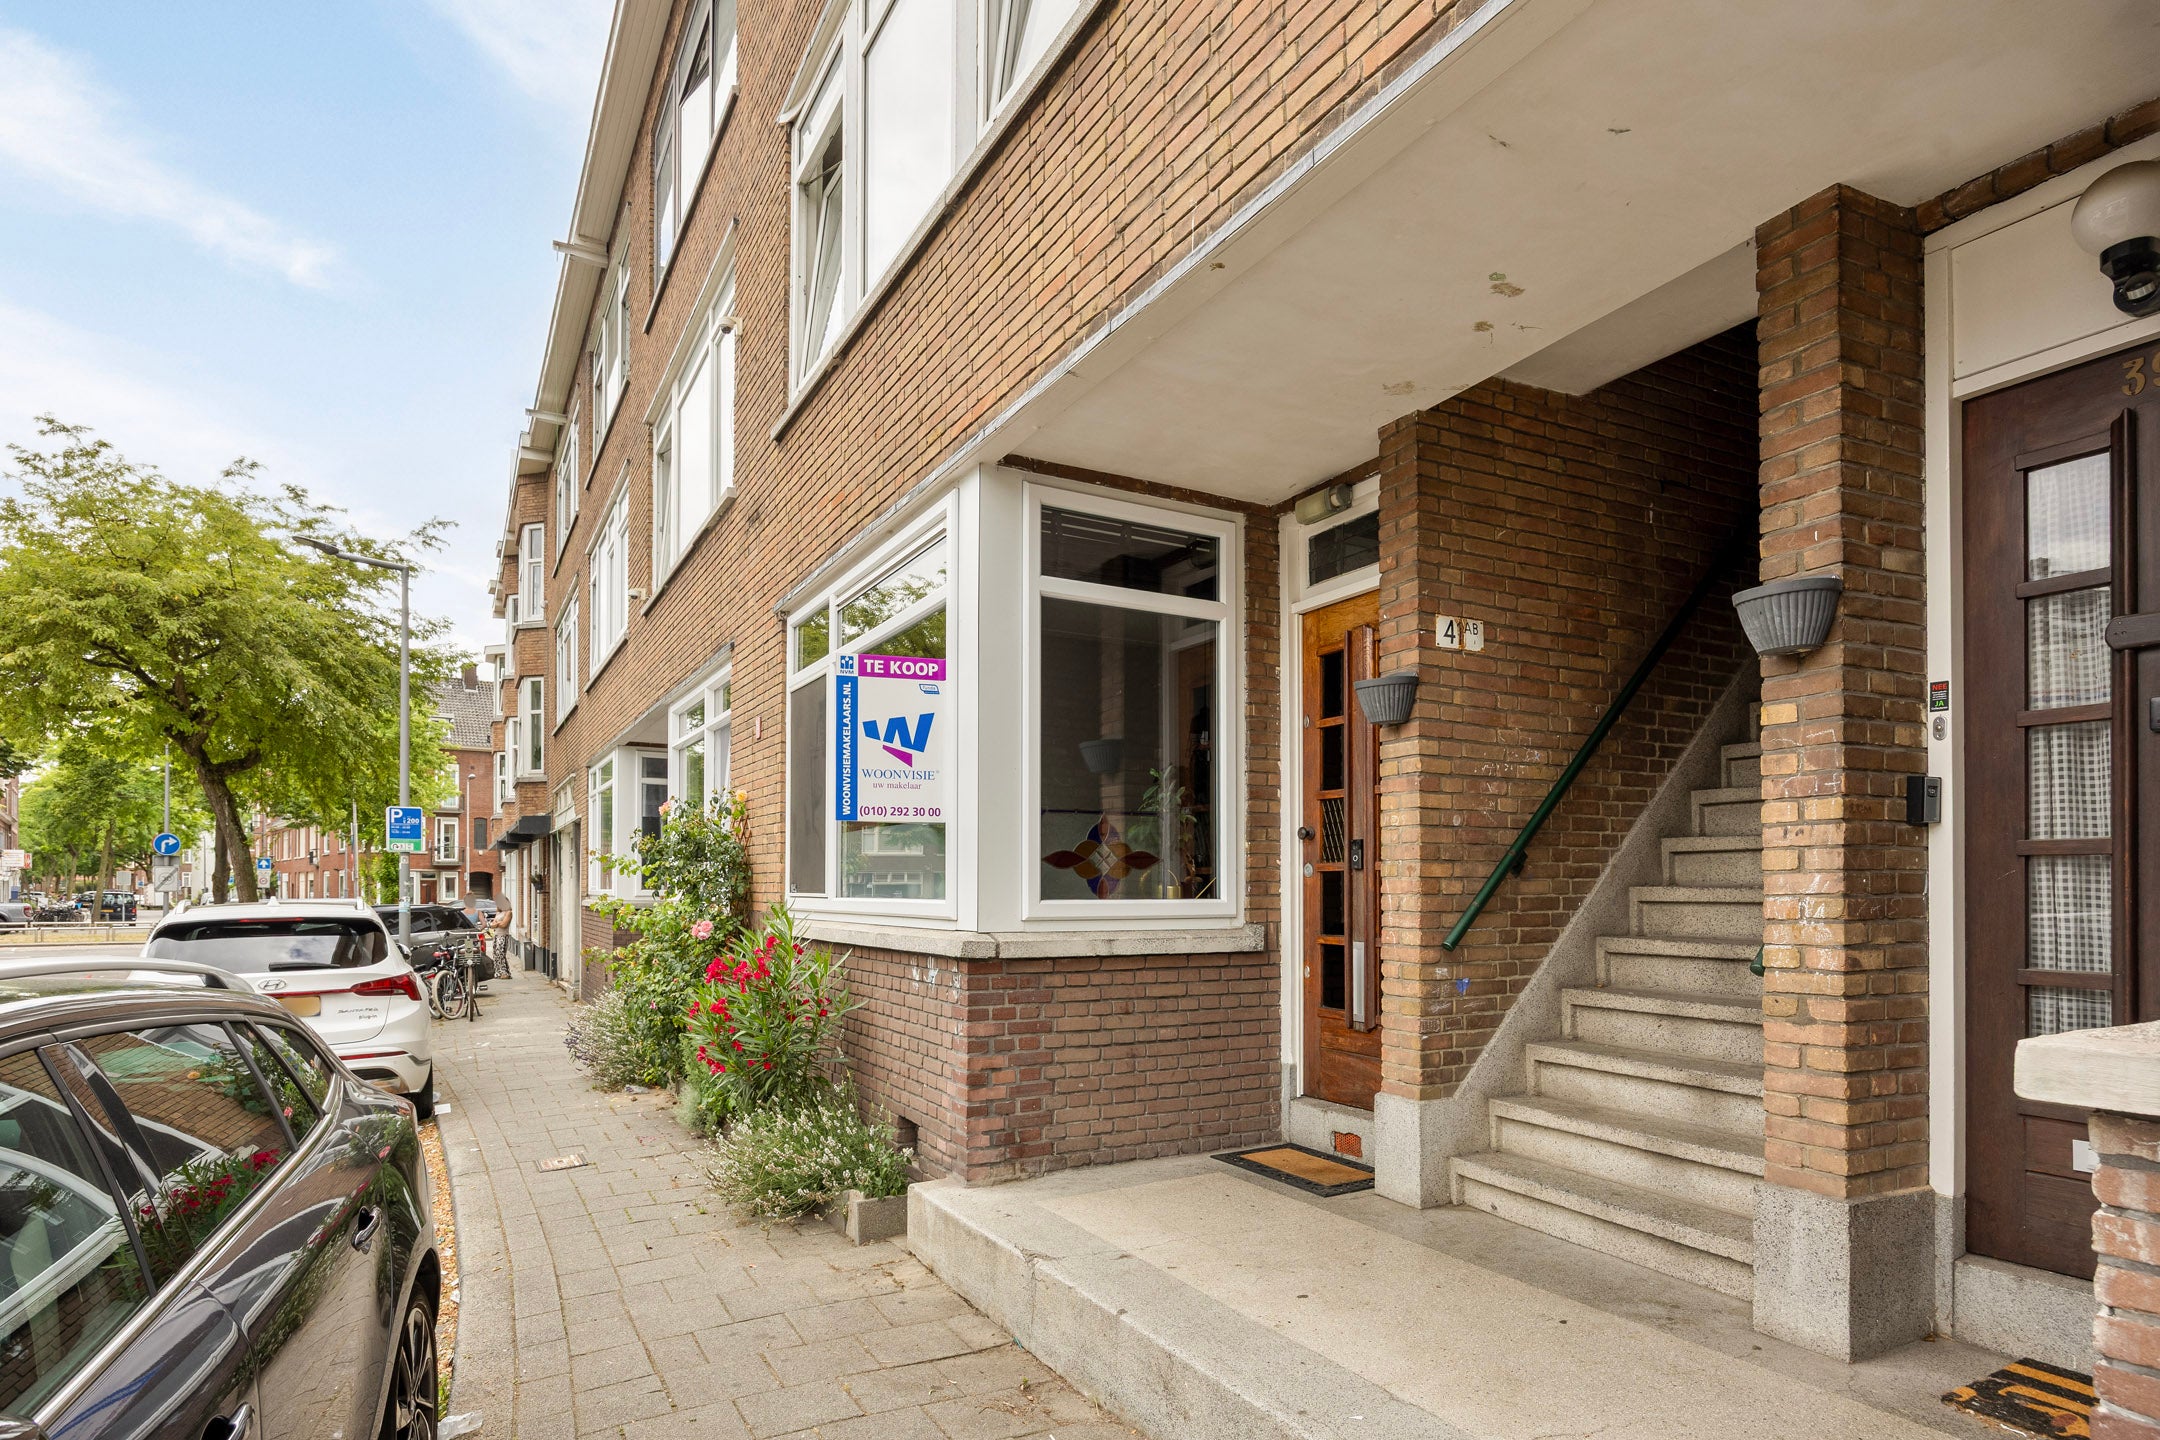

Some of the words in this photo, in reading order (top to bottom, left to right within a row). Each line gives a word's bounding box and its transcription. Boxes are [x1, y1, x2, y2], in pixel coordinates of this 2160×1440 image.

[1465, 622, 1479, 635] AB
[864, 660, 884, 673] TE
[890, 661, 939, 676] KOOP
[842, 682, 851, 815] WOONVISIEMAKELAARS.NL
[862, 769, 935, 780] WOONVISIE
[887, 782, 922, 790] makelaar
[391, 809, 403, 823] P
[859, 806, 887, 817] (010)
[890, 807, 909, 817] 292
[912, 807, 925, 816] 30
[929, 808, 941, 817] 00
